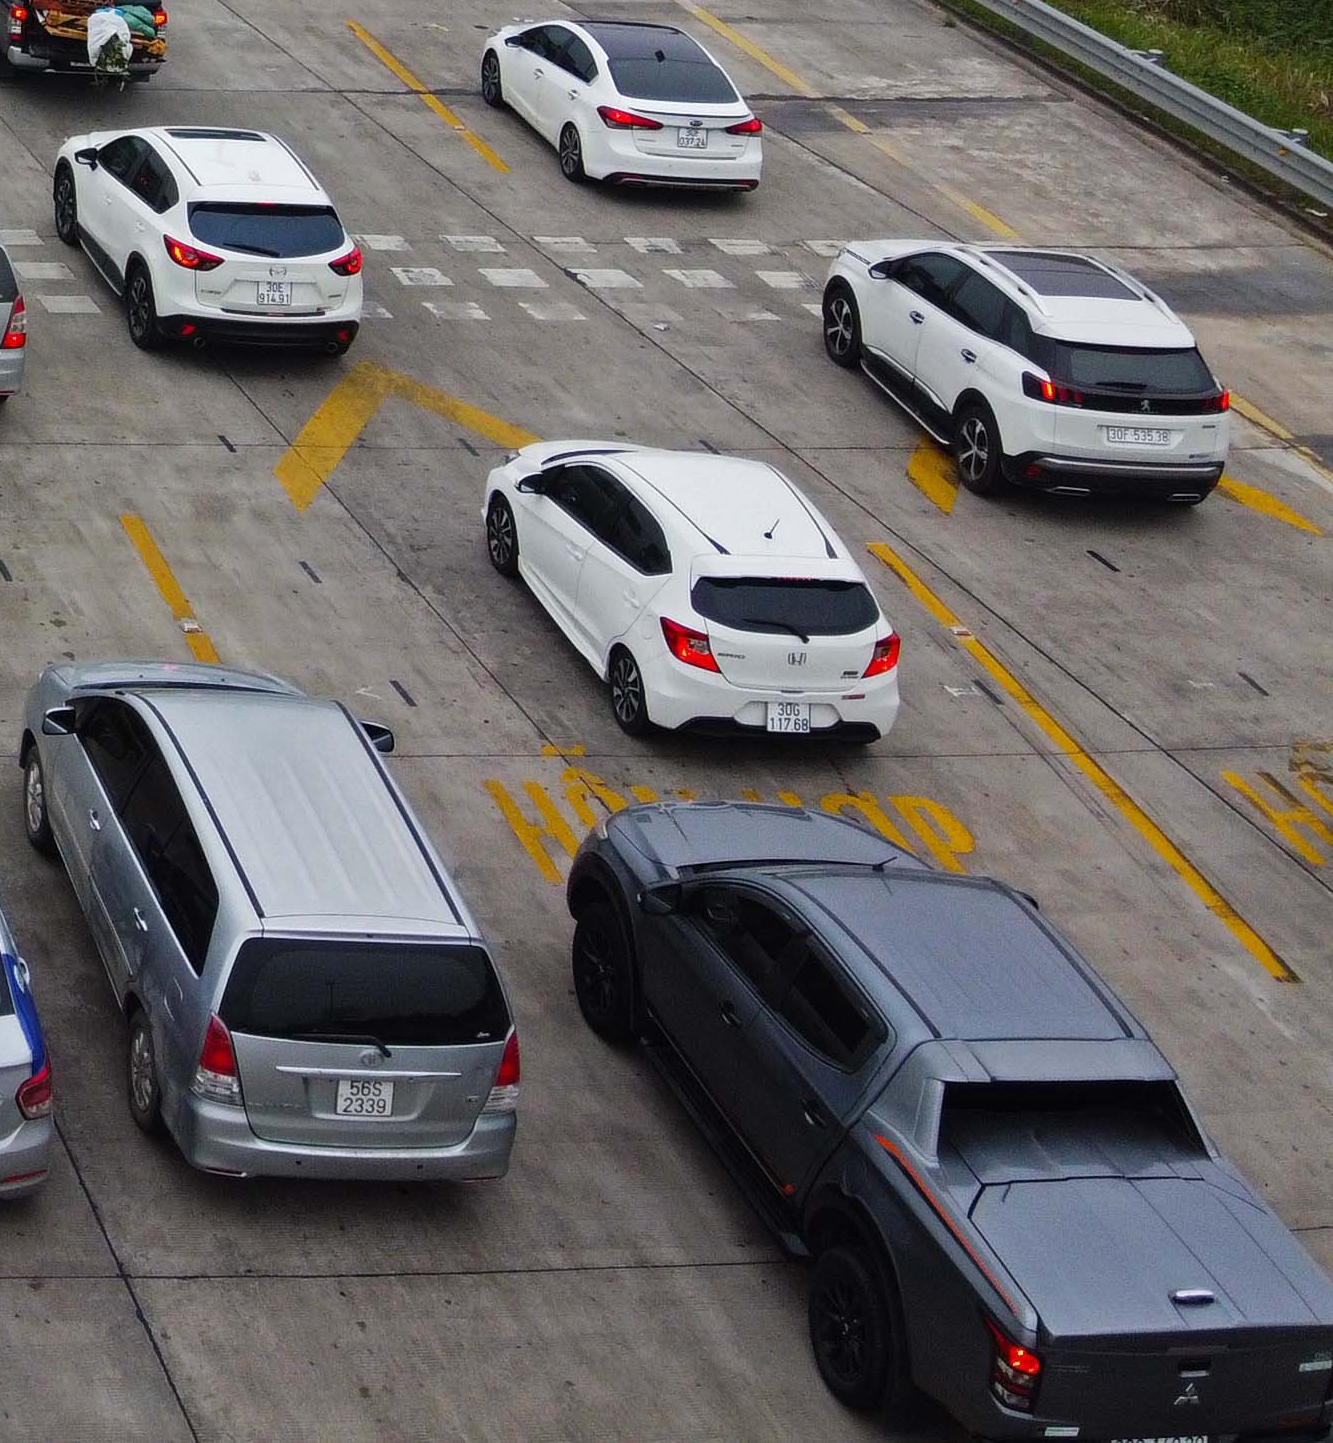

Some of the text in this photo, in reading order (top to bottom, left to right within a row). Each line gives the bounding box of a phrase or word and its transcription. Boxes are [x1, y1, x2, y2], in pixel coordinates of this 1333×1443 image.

[266, 282, 284, 293] 30E
[259, 293, 289, 304] 914.91
[777, 703, 801, 717] 30G
[770, 717, 809, 731] 117.68
[350, 1081, 383, 1097] 56S
[342, 1097, 387, 1114] 2339
